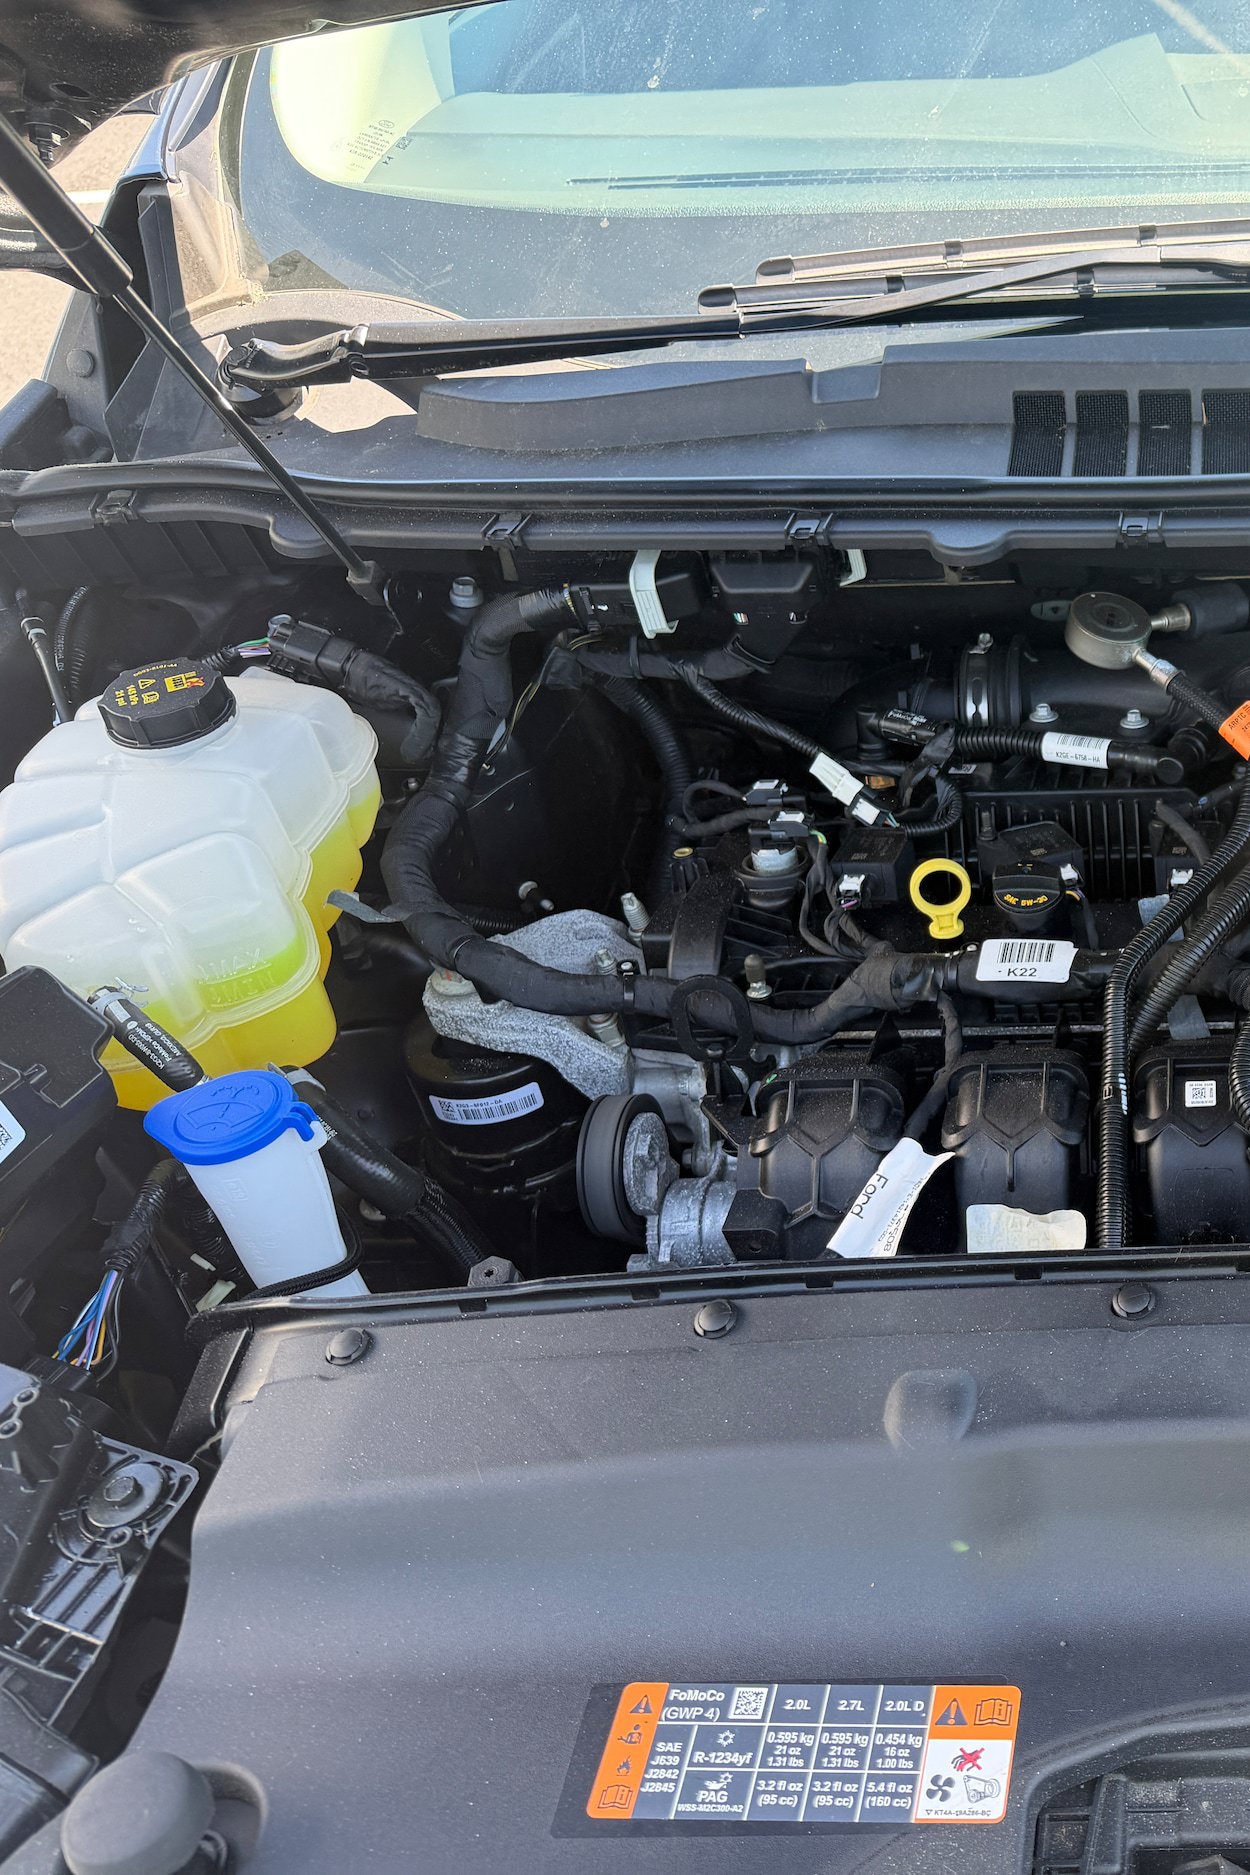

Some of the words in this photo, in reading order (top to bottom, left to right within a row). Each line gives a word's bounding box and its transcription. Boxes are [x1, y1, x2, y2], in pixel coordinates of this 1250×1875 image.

[1003, 893, 1019, 905] SAE
[1021, 895, 1048, 906] 5W-30
[1007, 967, 1037, 977] K22
[850, 1173, 889, 1220] Ford
[669, 1689, 725, 1701] FoMoCo
[784, 1699, 811, 1710] 2.0L
[837, 1700, 865, 1711] 2.7L
[884, 1700, 912, 1711] 2.0L
[913, 1701, 925, 1711] D
[661, 1707, 704, 1722] (GWP
[704, 1707, 721, 1722] 4)
[767, 1731, 798, 1743] 0.595
[800, 1732, 815, 1747] kg
[821, 1732, 852, 1744] 0.595
[854, 1733, 869, 1747] kg
[875, 1733, 906, 1745] 0.454
[908, 1734, 923, 1748] kg
[655, 1742, 683, 1752] SAE
[774, 1745, 788, 1755] 21
[788, 1747, 802, 1755] oz
[828, 1746, 841, 1756] 21
[843, 1748, 856, 1756] oz
[884, 1747, 897, 1756] 16
[898, 1748, 911, 1757] oz
[650, 1755, 680, 1766] J639
[692, 1751, 753, 1767] R-1234yf
[767, 1756, 787, 1767] 1.31
[788, 1757, 804, 1767] lbs
[822, 1757, 841, 1768] 1.31
[843, 1757, 859, 1768] lbs
[876, 1758, 897, 1768] 1.00
[898, 1758, 914, 1768] lbs
[644, 1769, 679, 1779] J2842
[640, 1782, 676, 1793] J2845
[757, 1780, 776, 1791] 3.2
[776, 1780, 787, 1790] fl
[788, 1782, 804, 1791] oz
[812, 1781, 832, 1792] 3.2
[832, 1781, 842, 1791] fl
[843, 1783, 859, 1792] oz
[866, 1782, 886, 1793] 5.4
[887, 1782, 897, 1792] fl
[898, 1784, 913, 1793] oz
[696, 1790, 728, 1802] PAG
[758, 1794, 778, 1807] (95
[779, 1794, 798, 1808] cc)
[814, 1795, 833, 1808] (95
[834, 1795, 854, 1809] cc)
[865, 1796, 891, 1809] (160
[892, 1796, 912, 1809] cc)
